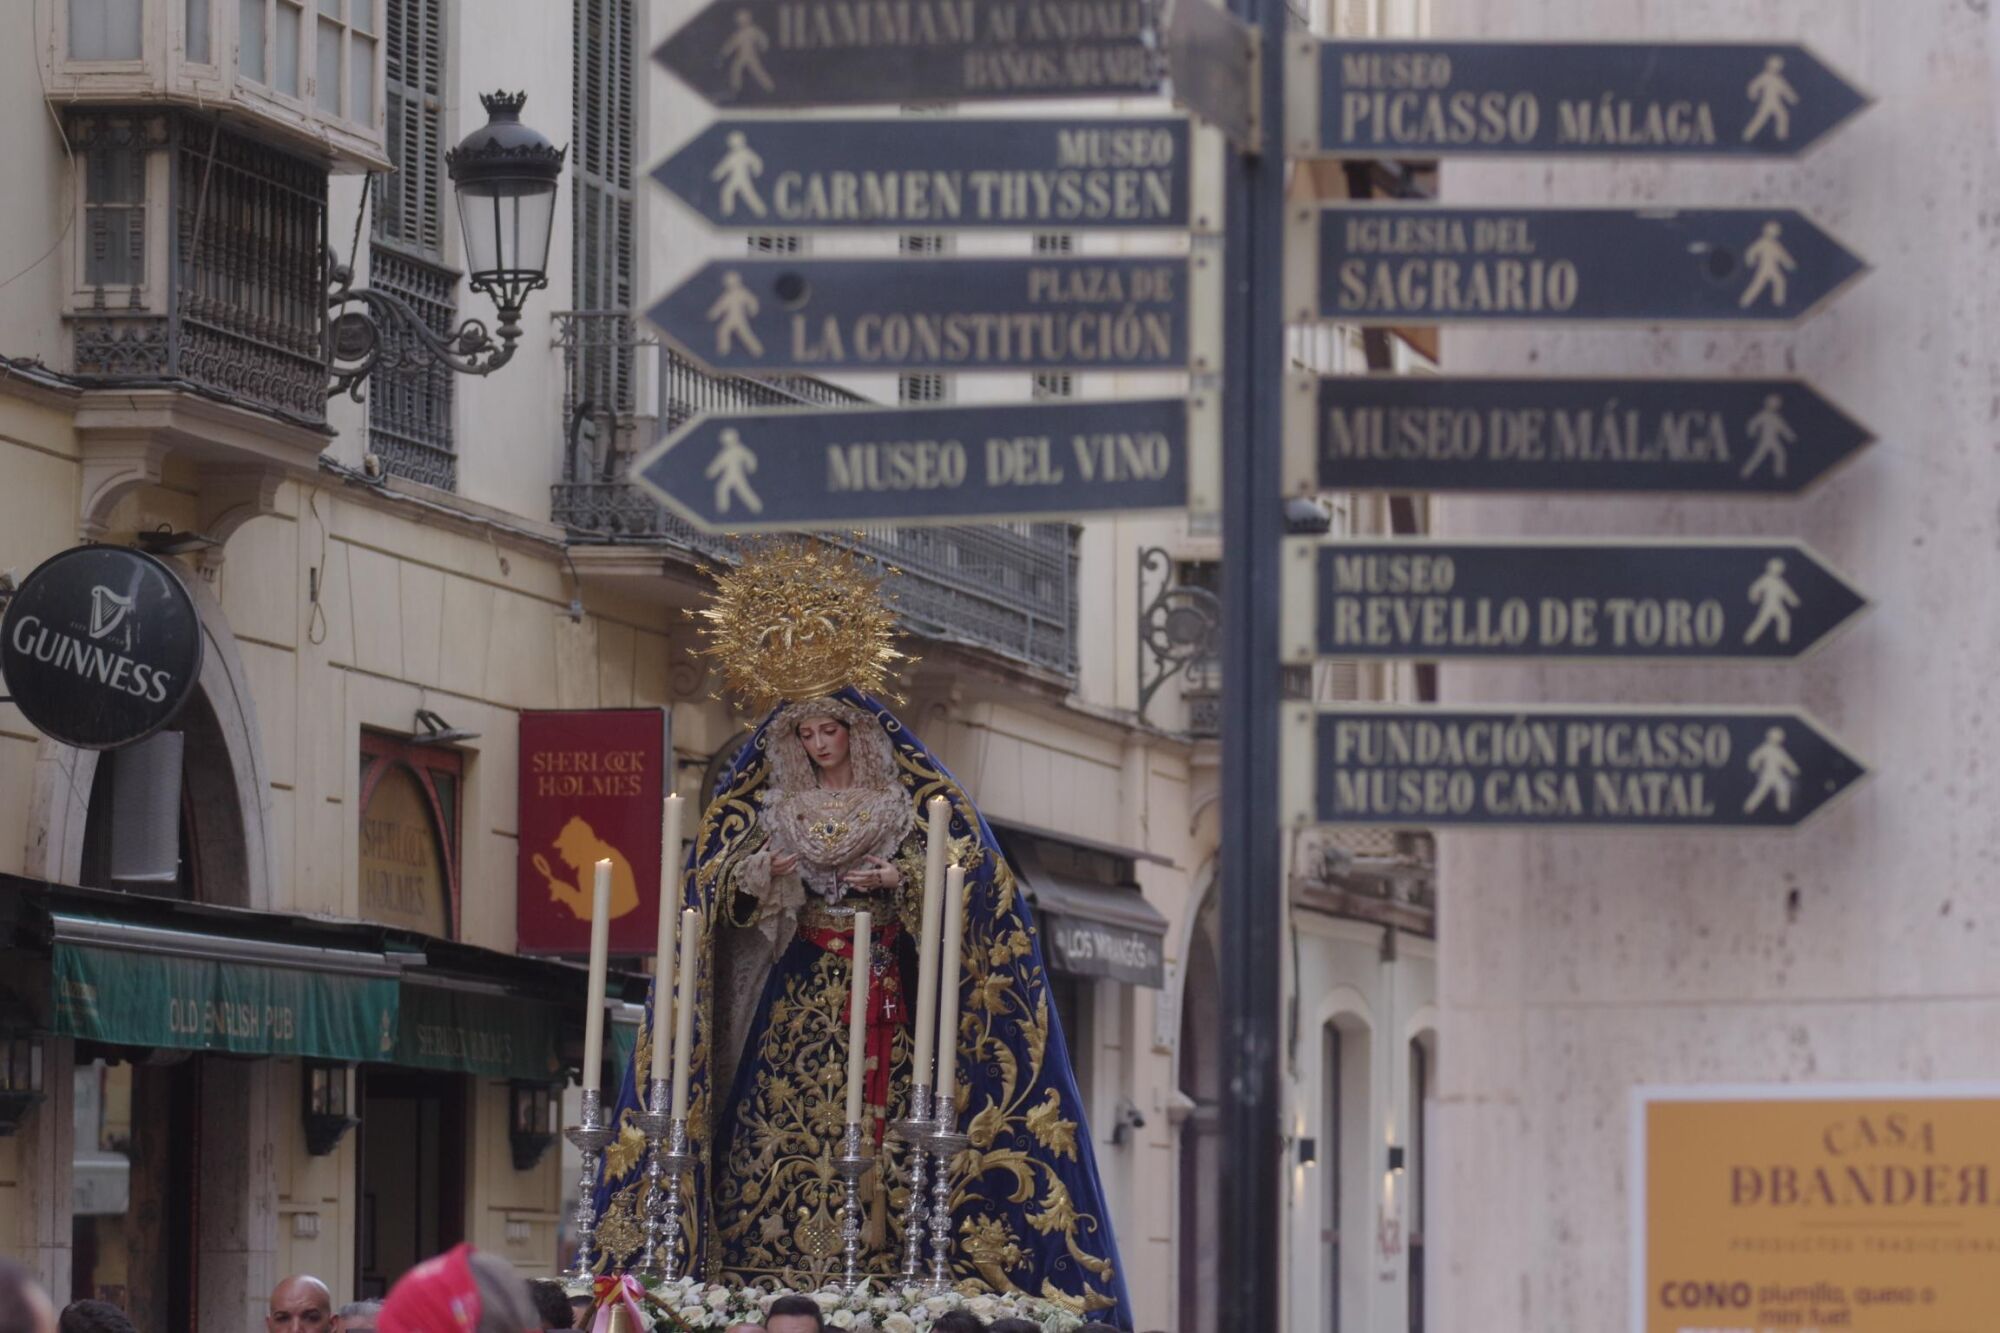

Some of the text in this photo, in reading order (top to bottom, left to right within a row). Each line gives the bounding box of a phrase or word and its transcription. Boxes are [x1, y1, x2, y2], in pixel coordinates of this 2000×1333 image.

[1340, 53, 1452, 89] MUSEO
[1340, 92, 1716, 145] PICASSO MÁLAGA
[1057, 129, 1175, 168] MUSEO
[774, 169, 1174, 220] CARMEN THYSSEN
[1345, 218, 1536, 254] IGLESIA DEL
[1027, 267, 1175, 302] PLAZA DE
[1339, 258, 1579, 312] SAGRARIO
[792, 305, 1173, 362] LA CONSTITUCIÓN
[1326, 397, 1731, 463] MUSEO DE MÁLAGA
[826, 432, 1171, 493] MUSEO DEL VINO
[1333, 555, 1456, 594] MUSEO
[1333, 597, 1725, 648] REVELLO DE TORO
[12, 615, 172, 703] GUINNESS
[532, 751, 646, 774] SHERLOCK
[1333, 713, 1731, 768] FUNDACIÓN PICASSO
[538, 774, 643, 798] HOLMES
[1333, 770, 1715, 818] MUSEO CASA NATAL
[169, 998, 199, 1034] OLD
[265, 1004, 294, 1040] PUB
[1822, 1110, 1936, 1157] CASA
[1660, 1281, 1753, 1310] CONO
